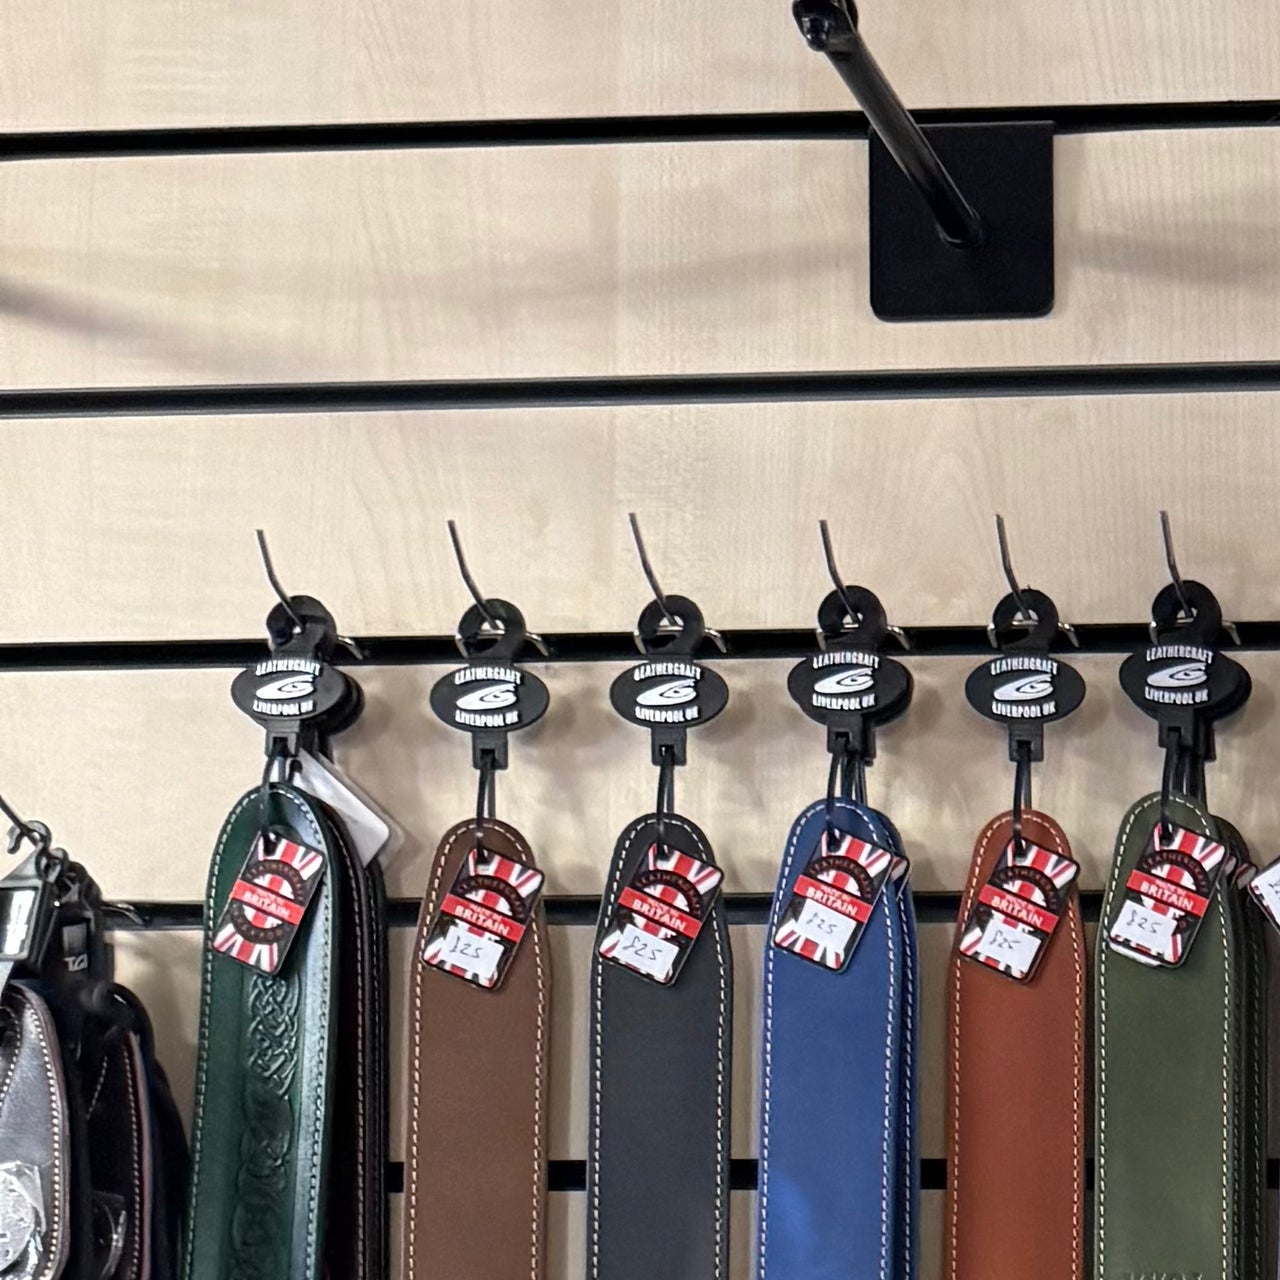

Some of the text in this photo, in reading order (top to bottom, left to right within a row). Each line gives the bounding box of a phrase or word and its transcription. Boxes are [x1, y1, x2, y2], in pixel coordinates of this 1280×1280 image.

[812, 693, 875, 710] LIVERPOOL UK
[991, 701, 1056, 718] LIVERPOOL UK
[1145, 686, 1208, 704] LIVERPOOL UK
[806, 886, 858, 916] BRITAIN
[1140, 880, 1194, 910] BRITAIN
[454, 905, 509, 936] BRITAIN
[632, 898, 687, 931] BRITAIN
[991, 895, 1043, 926] BRITAIN
